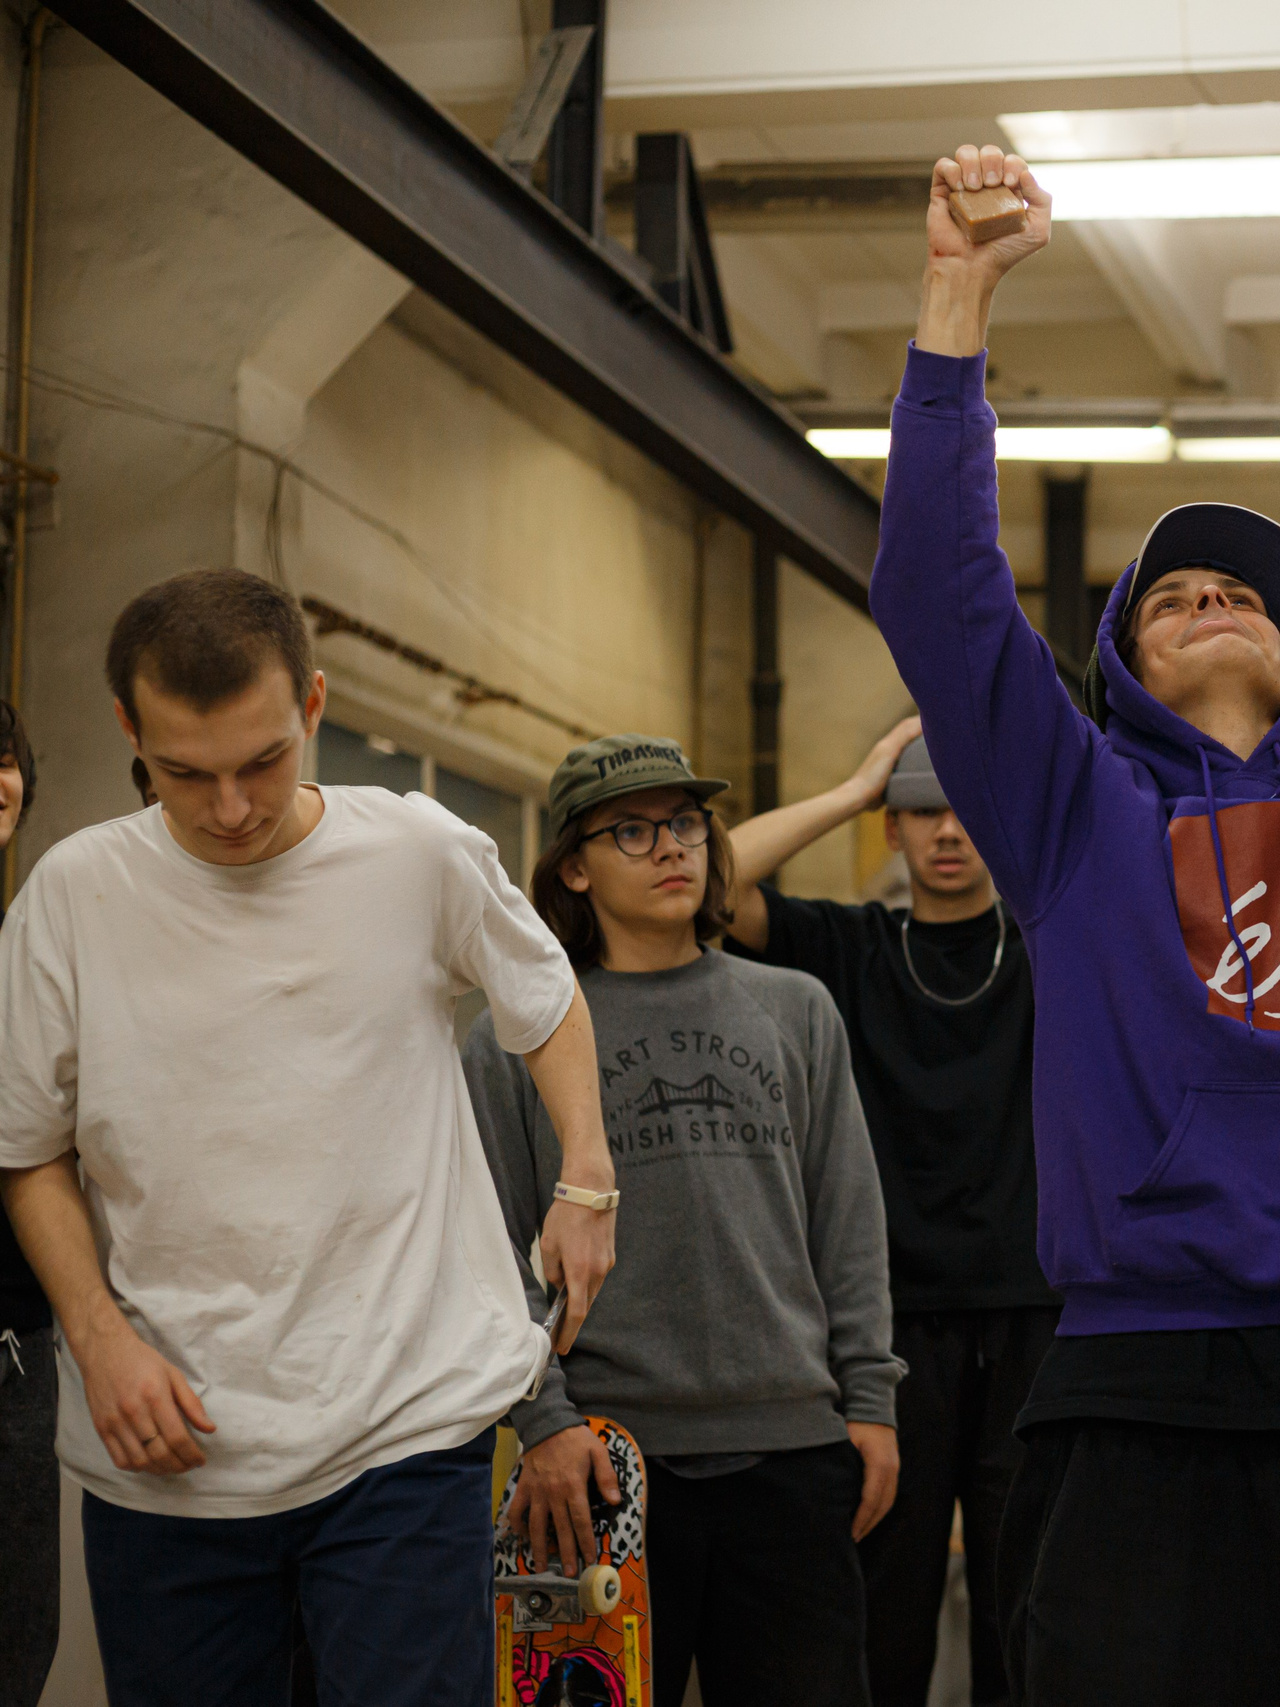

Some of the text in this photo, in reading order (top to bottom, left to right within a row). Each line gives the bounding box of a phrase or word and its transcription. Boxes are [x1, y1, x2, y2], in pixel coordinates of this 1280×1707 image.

[592, 744, 682, 779] THRASHER
[601, 1030, 783, 1102] ART STRONG
[608, 1123, 674, 1154] NISH
